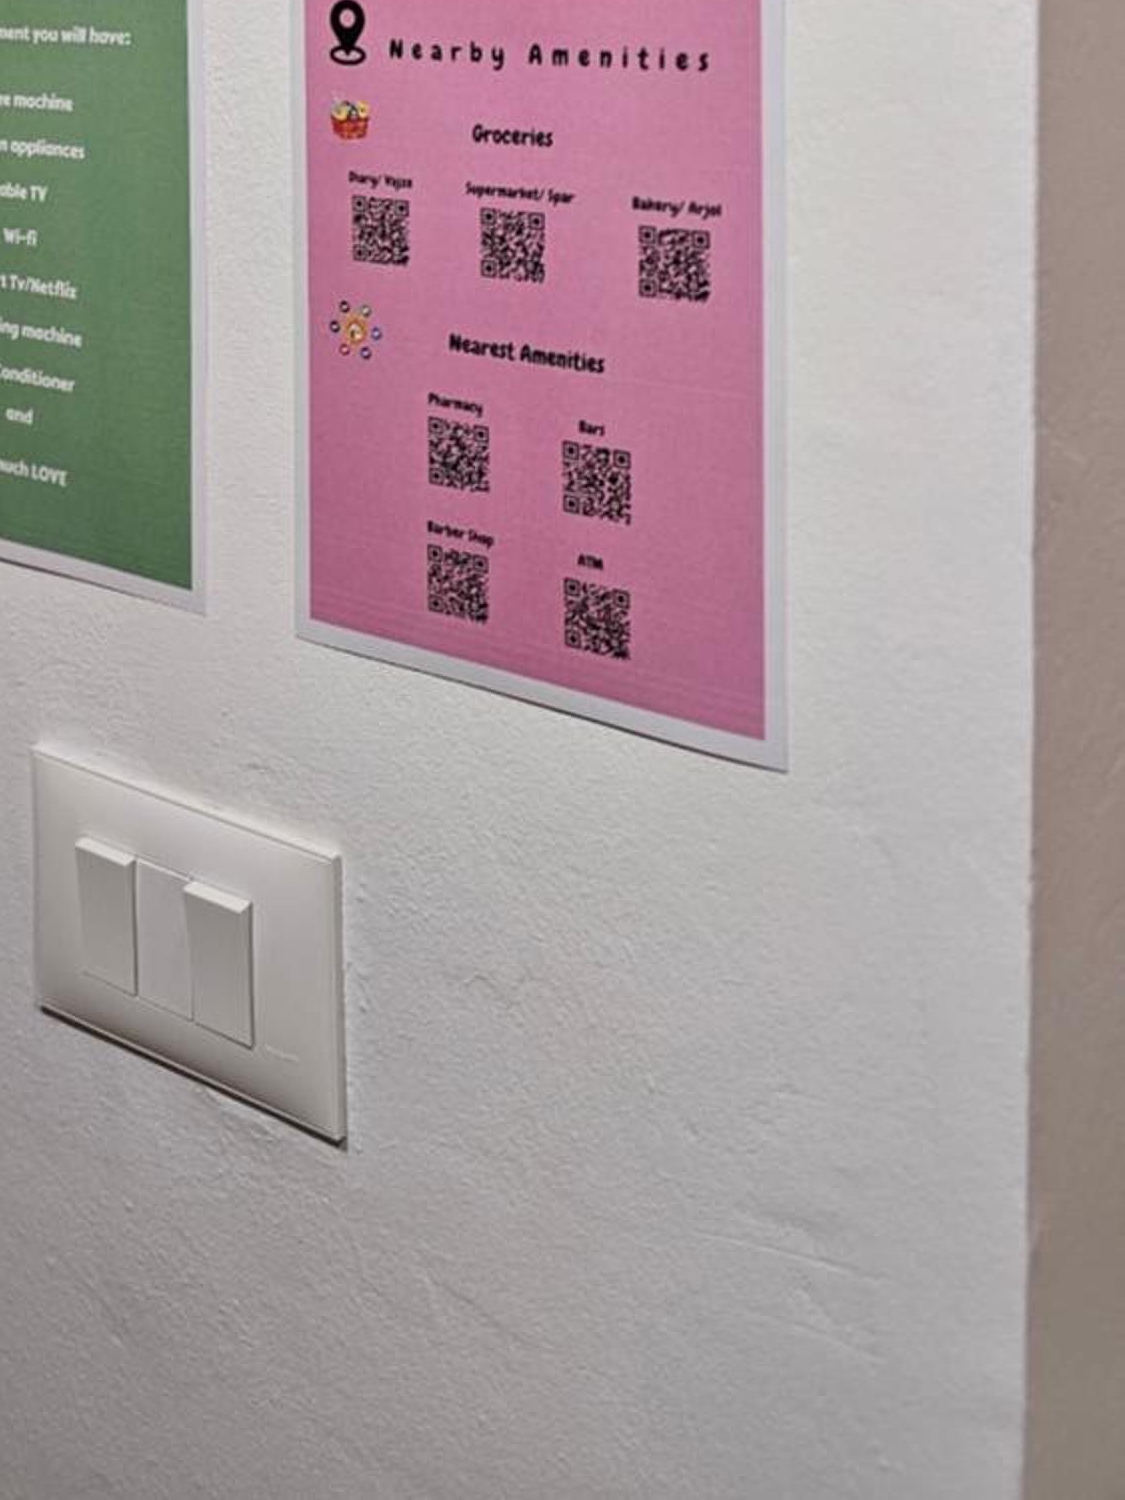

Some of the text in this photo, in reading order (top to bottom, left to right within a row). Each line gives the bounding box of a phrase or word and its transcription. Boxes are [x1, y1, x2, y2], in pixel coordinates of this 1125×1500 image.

[33, 29, 58, 44] you
[61, 26, 87, 43] will
[89, 27, 132, 46] have:
[389, 38, 709, 71] Nearby Amenities
[13, 93, 74, 112] machine
[472, 124, 554, 147] Groceries
[10, 139, 85, 159] appliances
[30, 185, 48, 202] TV
[3, 227, 38, 247] Wi-fi
[10, 274, 78, 300] Tv/Netflix
[22, 326, 82, 348] machine
[449, 332, 605, 373] Nearest Amenities
[427, 391, 484, 418] Pharmacy
[6, 408, 34, 425] and
[32, 464, 68, 487] LOVE
[427, 520, 464, 539] Barber
